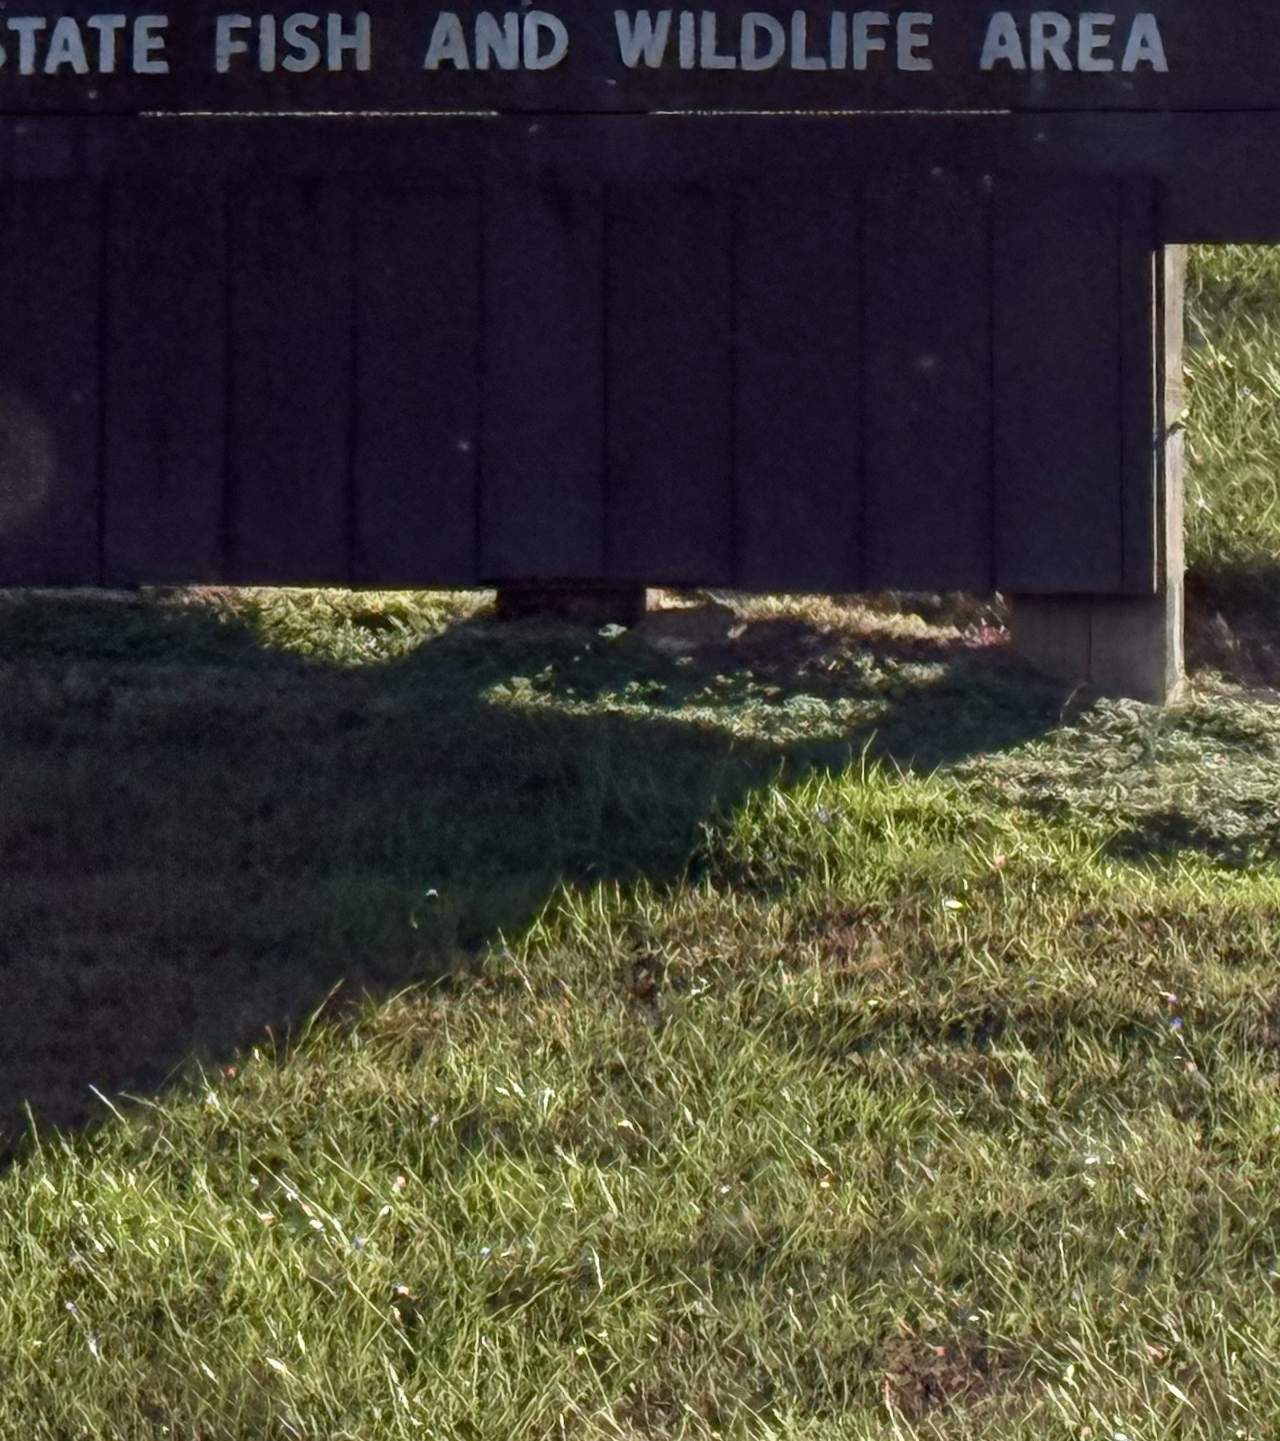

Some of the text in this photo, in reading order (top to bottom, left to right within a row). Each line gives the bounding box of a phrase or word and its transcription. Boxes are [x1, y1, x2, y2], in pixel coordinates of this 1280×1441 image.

[214, 11, 371, 73] FISH
[424, 10, 569, 72] AND
[614, 9, 933, 72] WILDLIFE
[980, 10, 1169, 73] AREA
